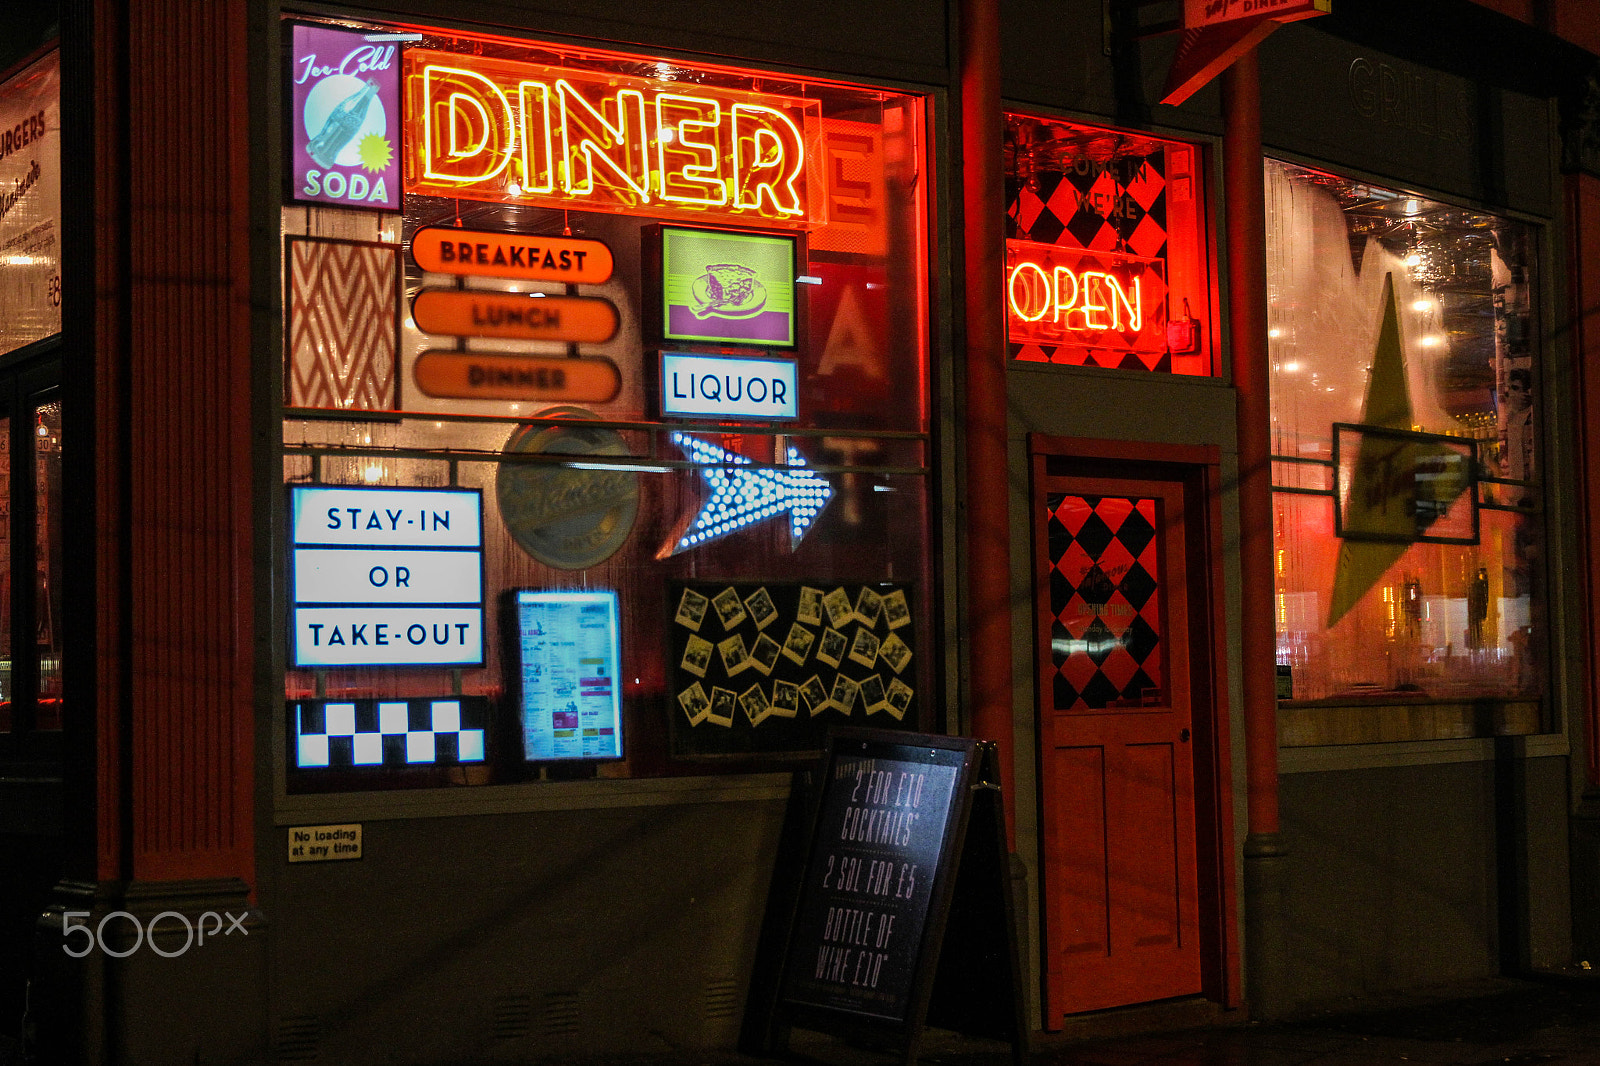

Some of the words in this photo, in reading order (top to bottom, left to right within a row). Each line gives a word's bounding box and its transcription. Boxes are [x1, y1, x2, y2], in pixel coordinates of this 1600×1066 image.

[1244, 0, 1288, 12] DINE
[425, 66, 804, 217] DINER
[1059, 151, 1120, 181] COME
[1127, 160, 1147, 184] IN
[303, 170, 389, 203] SODA
[1073, 190, 1137, 220] WE'RE
[440, 241, 587, 272] BREAKFAST
[1009, 261, 1141, 331] OPEN
[471, 303, 561, 329] LUNCH
[673, 360, 788, 404] LIQUOR
[327, 507, 451, 531] STAY-IN
[368, 566, 411, 588] OR
[309, 622, 471, 646] TAKE-OUT
[851, 769, 864, 803] 2
[865, 770, 893, 805] FOR
[292, 845, 304, 855] at
[309, 845, 329, 856] any
[334, 842, 358, 853] time
[294, 831, 310, 841] No
[315, 829, 356, 840] loading
[823, 854, 835, 888] 2
[837, 856, 862, 892] SOL
[866, 859, 893, 896] FOR
[896, 863, 917, 900] £5
[823, 906, 874, 946] BOTTLE
[876, 913, 896, 949] OF
[815, 944, 851, 983] WINE
